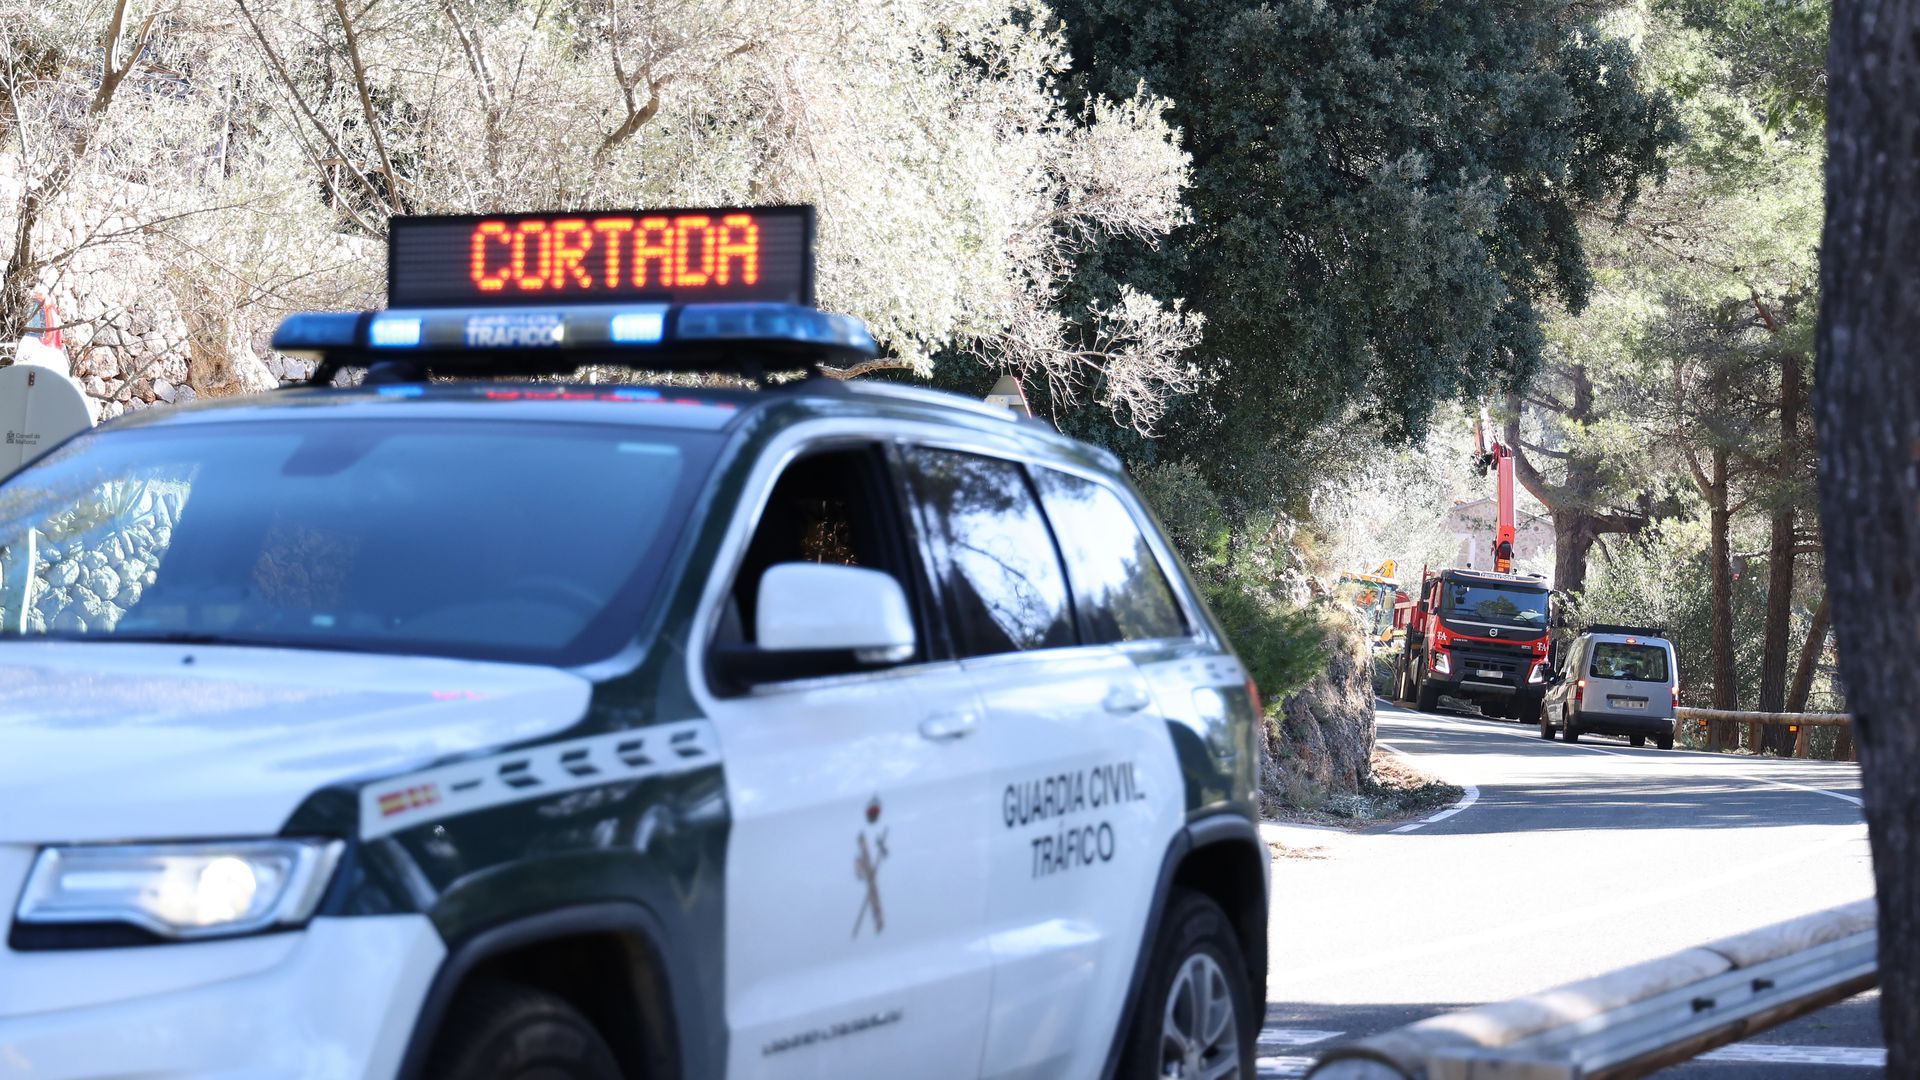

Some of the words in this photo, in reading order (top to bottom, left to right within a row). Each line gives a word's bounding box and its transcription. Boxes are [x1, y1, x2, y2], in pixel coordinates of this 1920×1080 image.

[470, 214, 760, 291] CORTADA
[1003, 769, 1085, 828] GUARDIA
[1089, 761, 1146, 808] CIVIL
[1031, 820, 1115, 879] TRÁFICO
